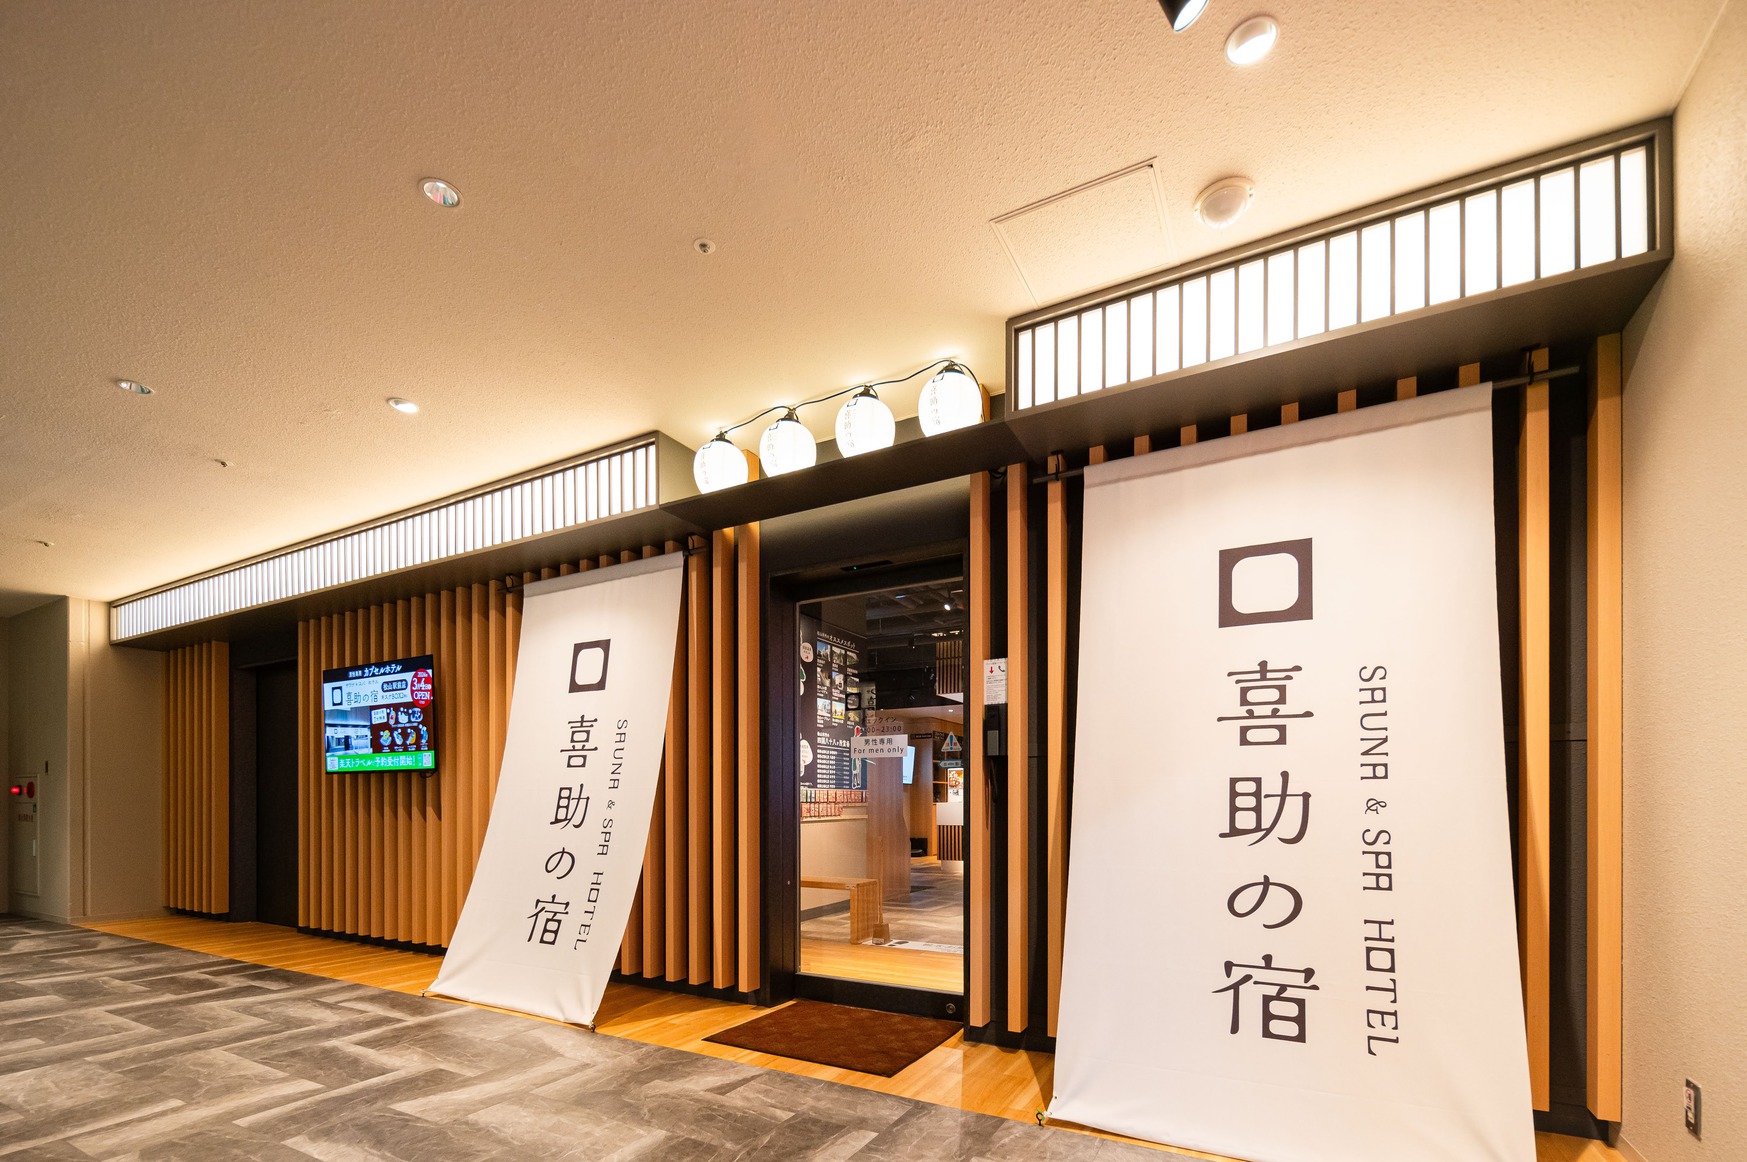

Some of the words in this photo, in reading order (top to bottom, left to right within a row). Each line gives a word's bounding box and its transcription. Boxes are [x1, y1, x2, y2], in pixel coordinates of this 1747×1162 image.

[345, 690, 379, 706] 喜助の宿
[1358, 665, 1389, 781] SAUNA
[607, 719, 629, 790] SAUNA
[863, 737, 893, 747] 男性専用
[887, 746, 905, 754] only
[527, 714, 599, 946] 喜助の宿
[605, 799, 616, 811] &
[1364, 797, 1388, 815] &
[596, 818, 614, 857] SPA
[1211, 659, 1320, 1044] 喜助の宿
[1362, 828, 1393, 892] SPA
[573, 871, 605, 952] HOTEL
[1363, 918, 1400, 1057] HOTEL
